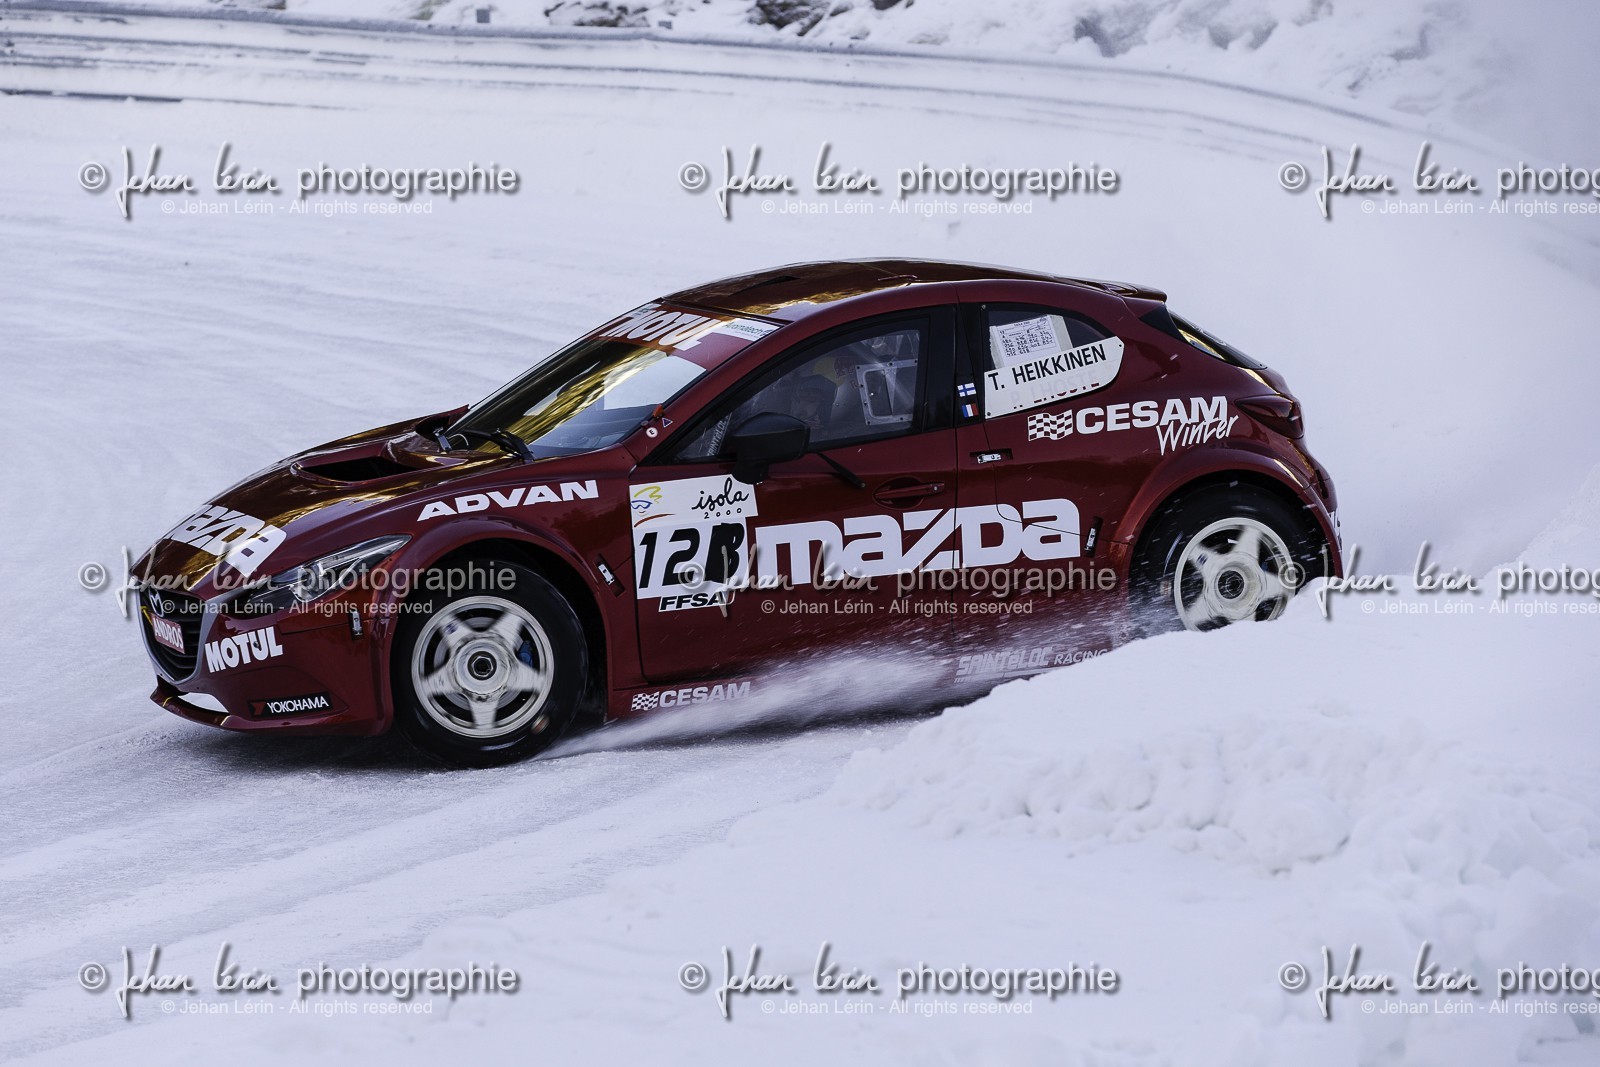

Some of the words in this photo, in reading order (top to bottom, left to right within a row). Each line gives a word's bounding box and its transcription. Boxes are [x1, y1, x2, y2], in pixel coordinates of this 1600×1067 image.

[988, 372, 1005, 390] T.
[1012, 344, 1106, 384] HEIKKINEN
[1075, 396, 1228, 434] CESAM
[1156, 415, 1239, 456] Winter
[417, 480, 599, 521] ADVAN
[692, 477, 749, 511] isola
[704, 508, 742, 519] 2000
[660, 592, 727, 611] FFSA
[153, 618, 184, 649] ANDROS
[205, 626, 283, 673] MOTUL
[267, 696, 330, 714] YOKOHAMA
[660, 681, 751, 708] CESAM
